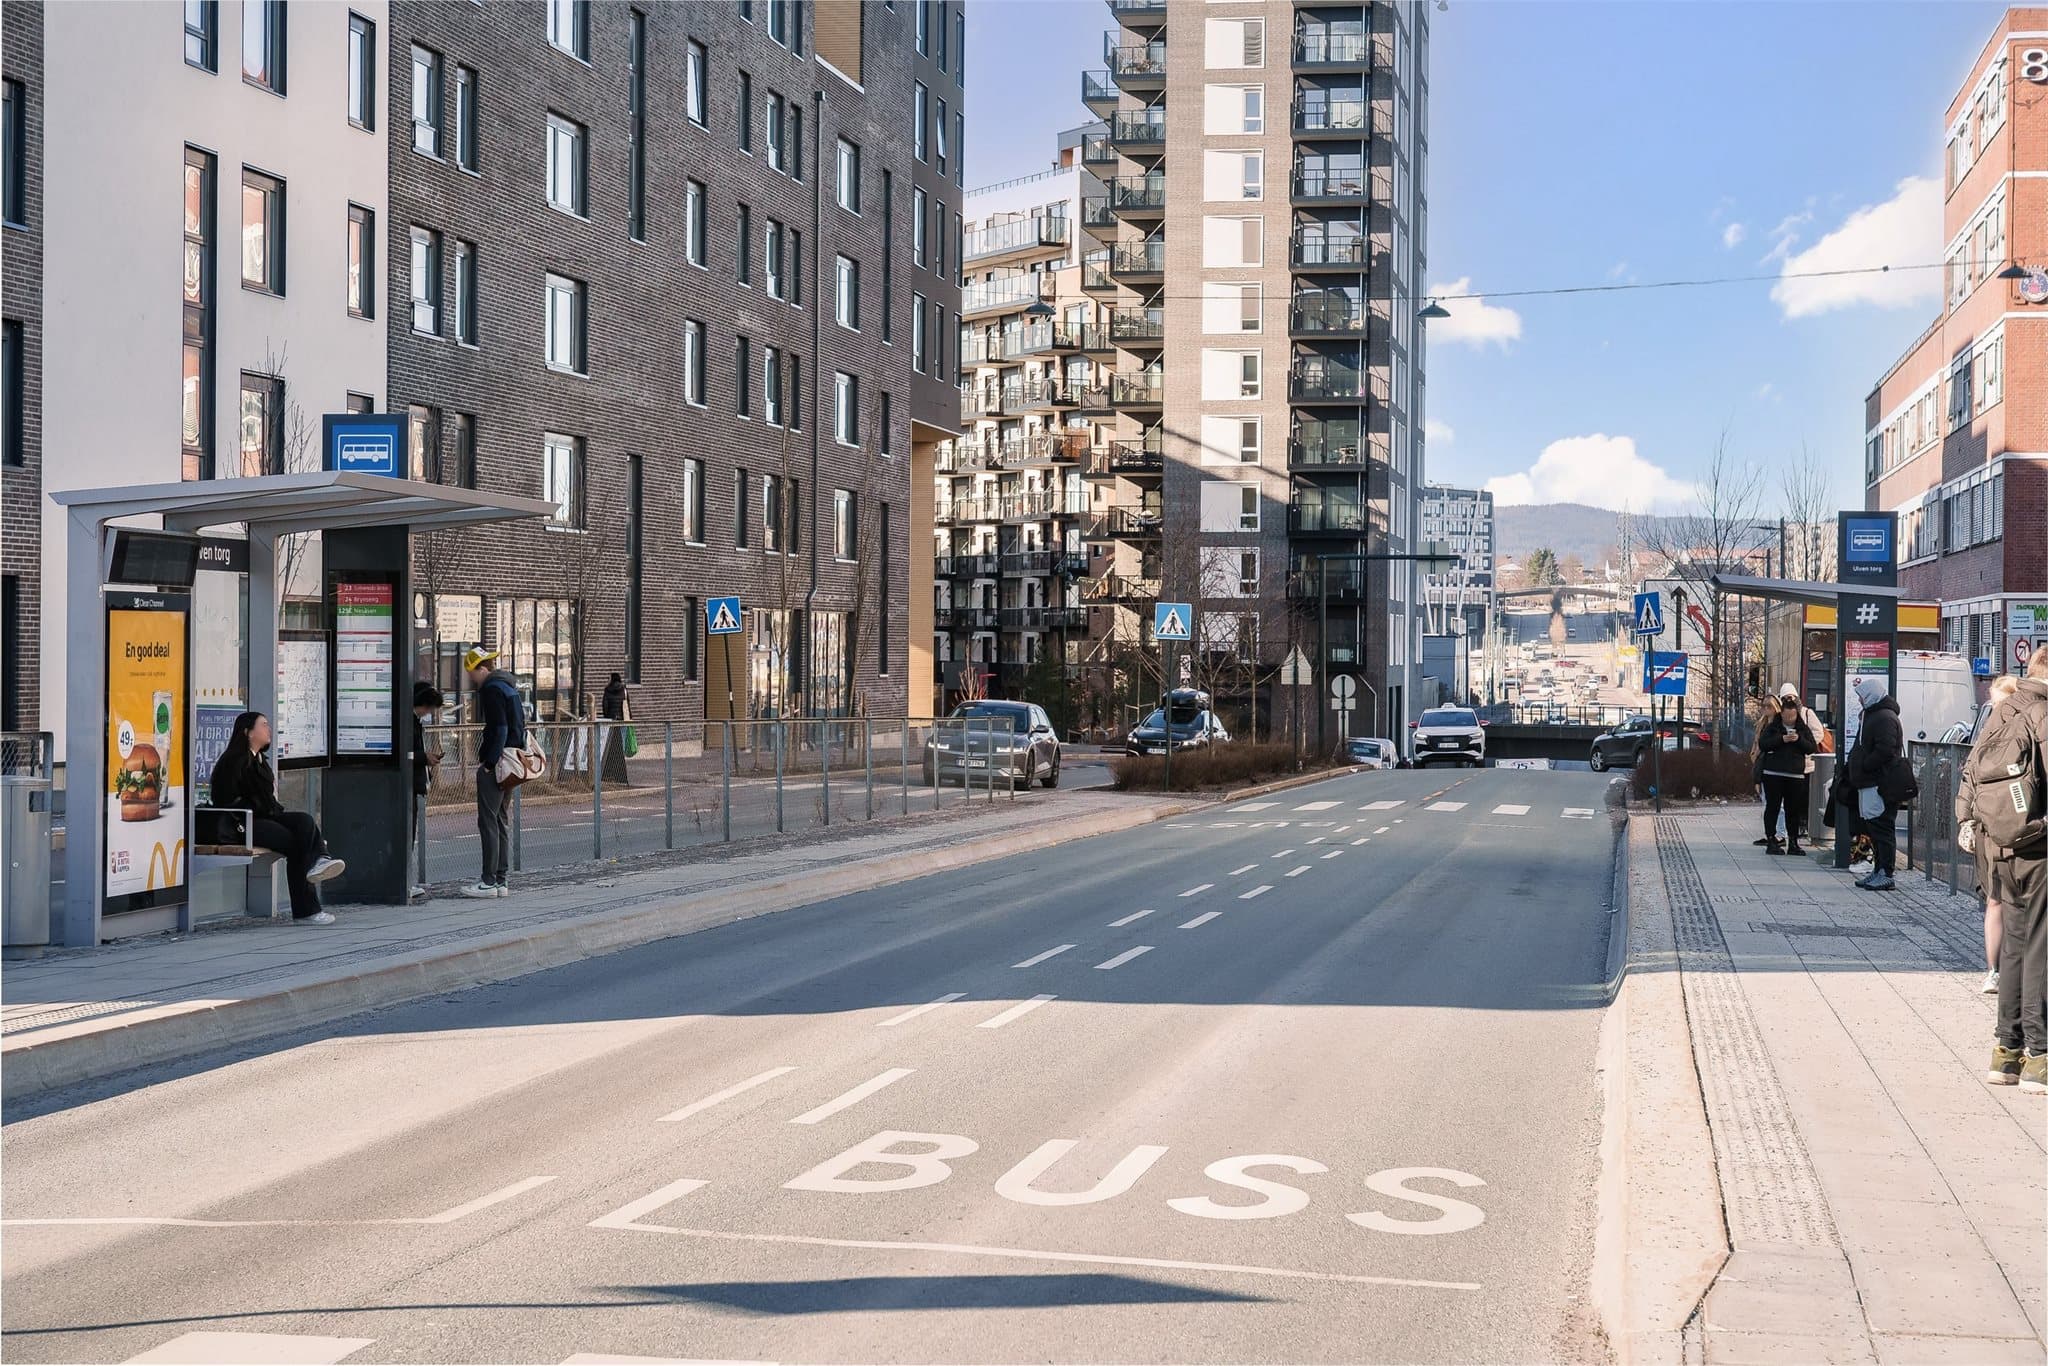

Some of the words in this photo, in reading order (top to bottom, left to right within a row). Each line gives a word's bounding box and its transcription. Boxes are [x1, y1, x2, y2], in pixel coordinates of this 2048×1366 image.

[214, 545, 231, 565] torg
[125, 642, 136, 658] En
[136, 641, 153, 662] god
[153, 641, 170, 658] deal
[782, 1129, 1488, 1235] BUSS
